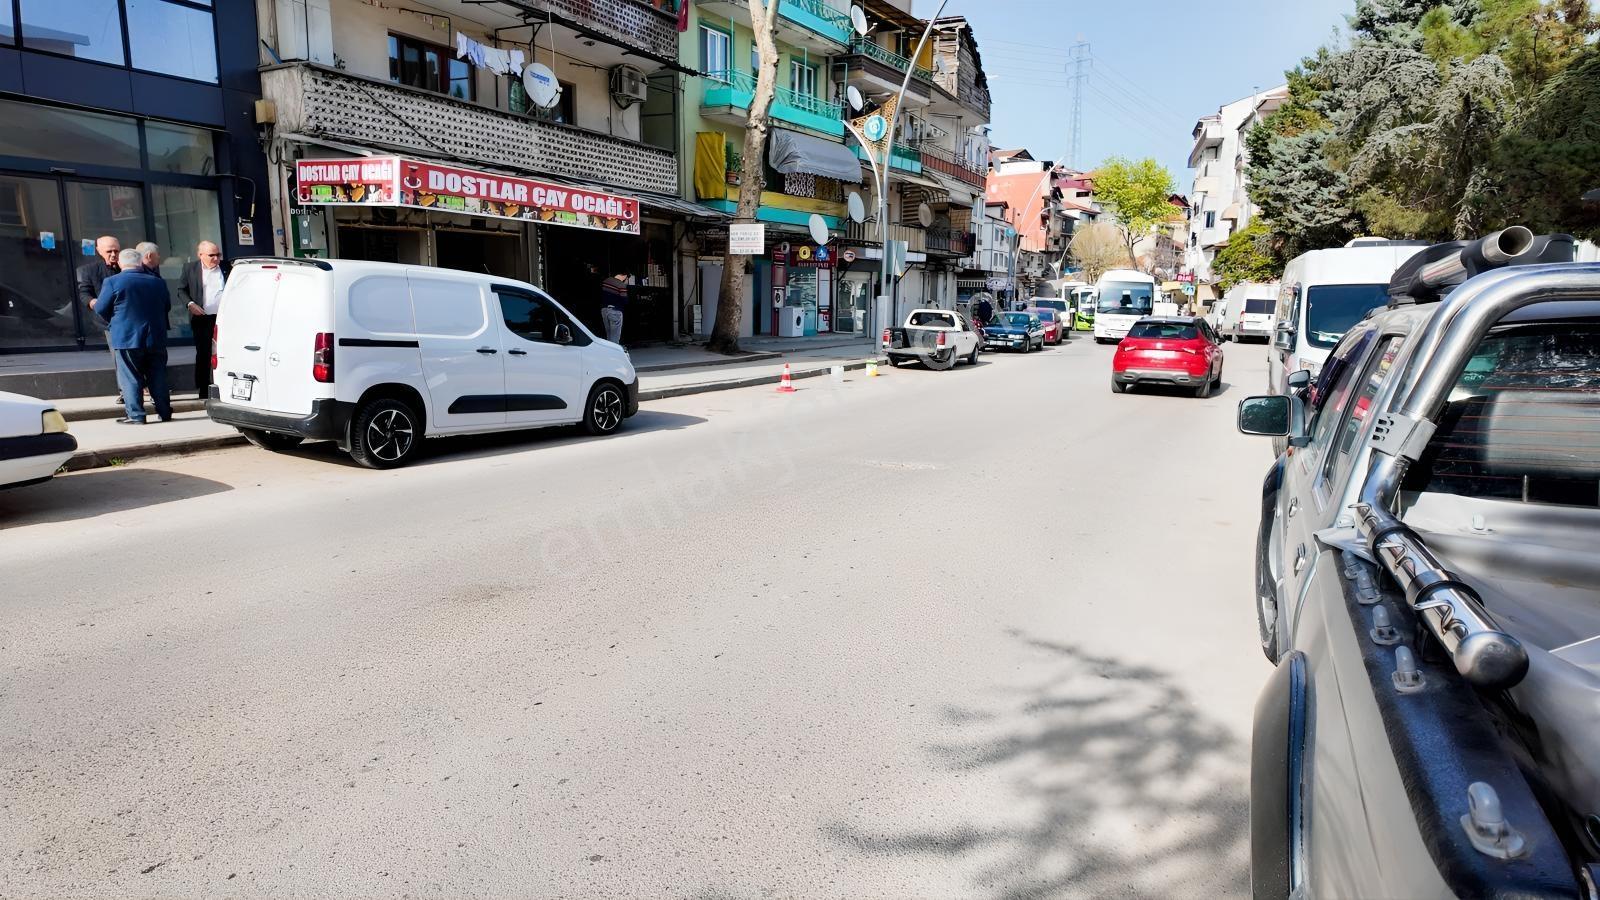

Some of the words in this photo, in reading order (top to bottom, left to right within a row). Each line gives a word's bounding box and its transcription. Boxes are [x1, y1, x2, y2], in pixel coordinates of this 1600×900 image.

[300, 165, 340, 182] DOSTLAR
[341, 164, 360, 184] ÇAY
[428, 170, 528, 202] DOSTLAR
[532, 186, 568, 208] ÇAY
[571, 193, 623, 217] OCAĞI
